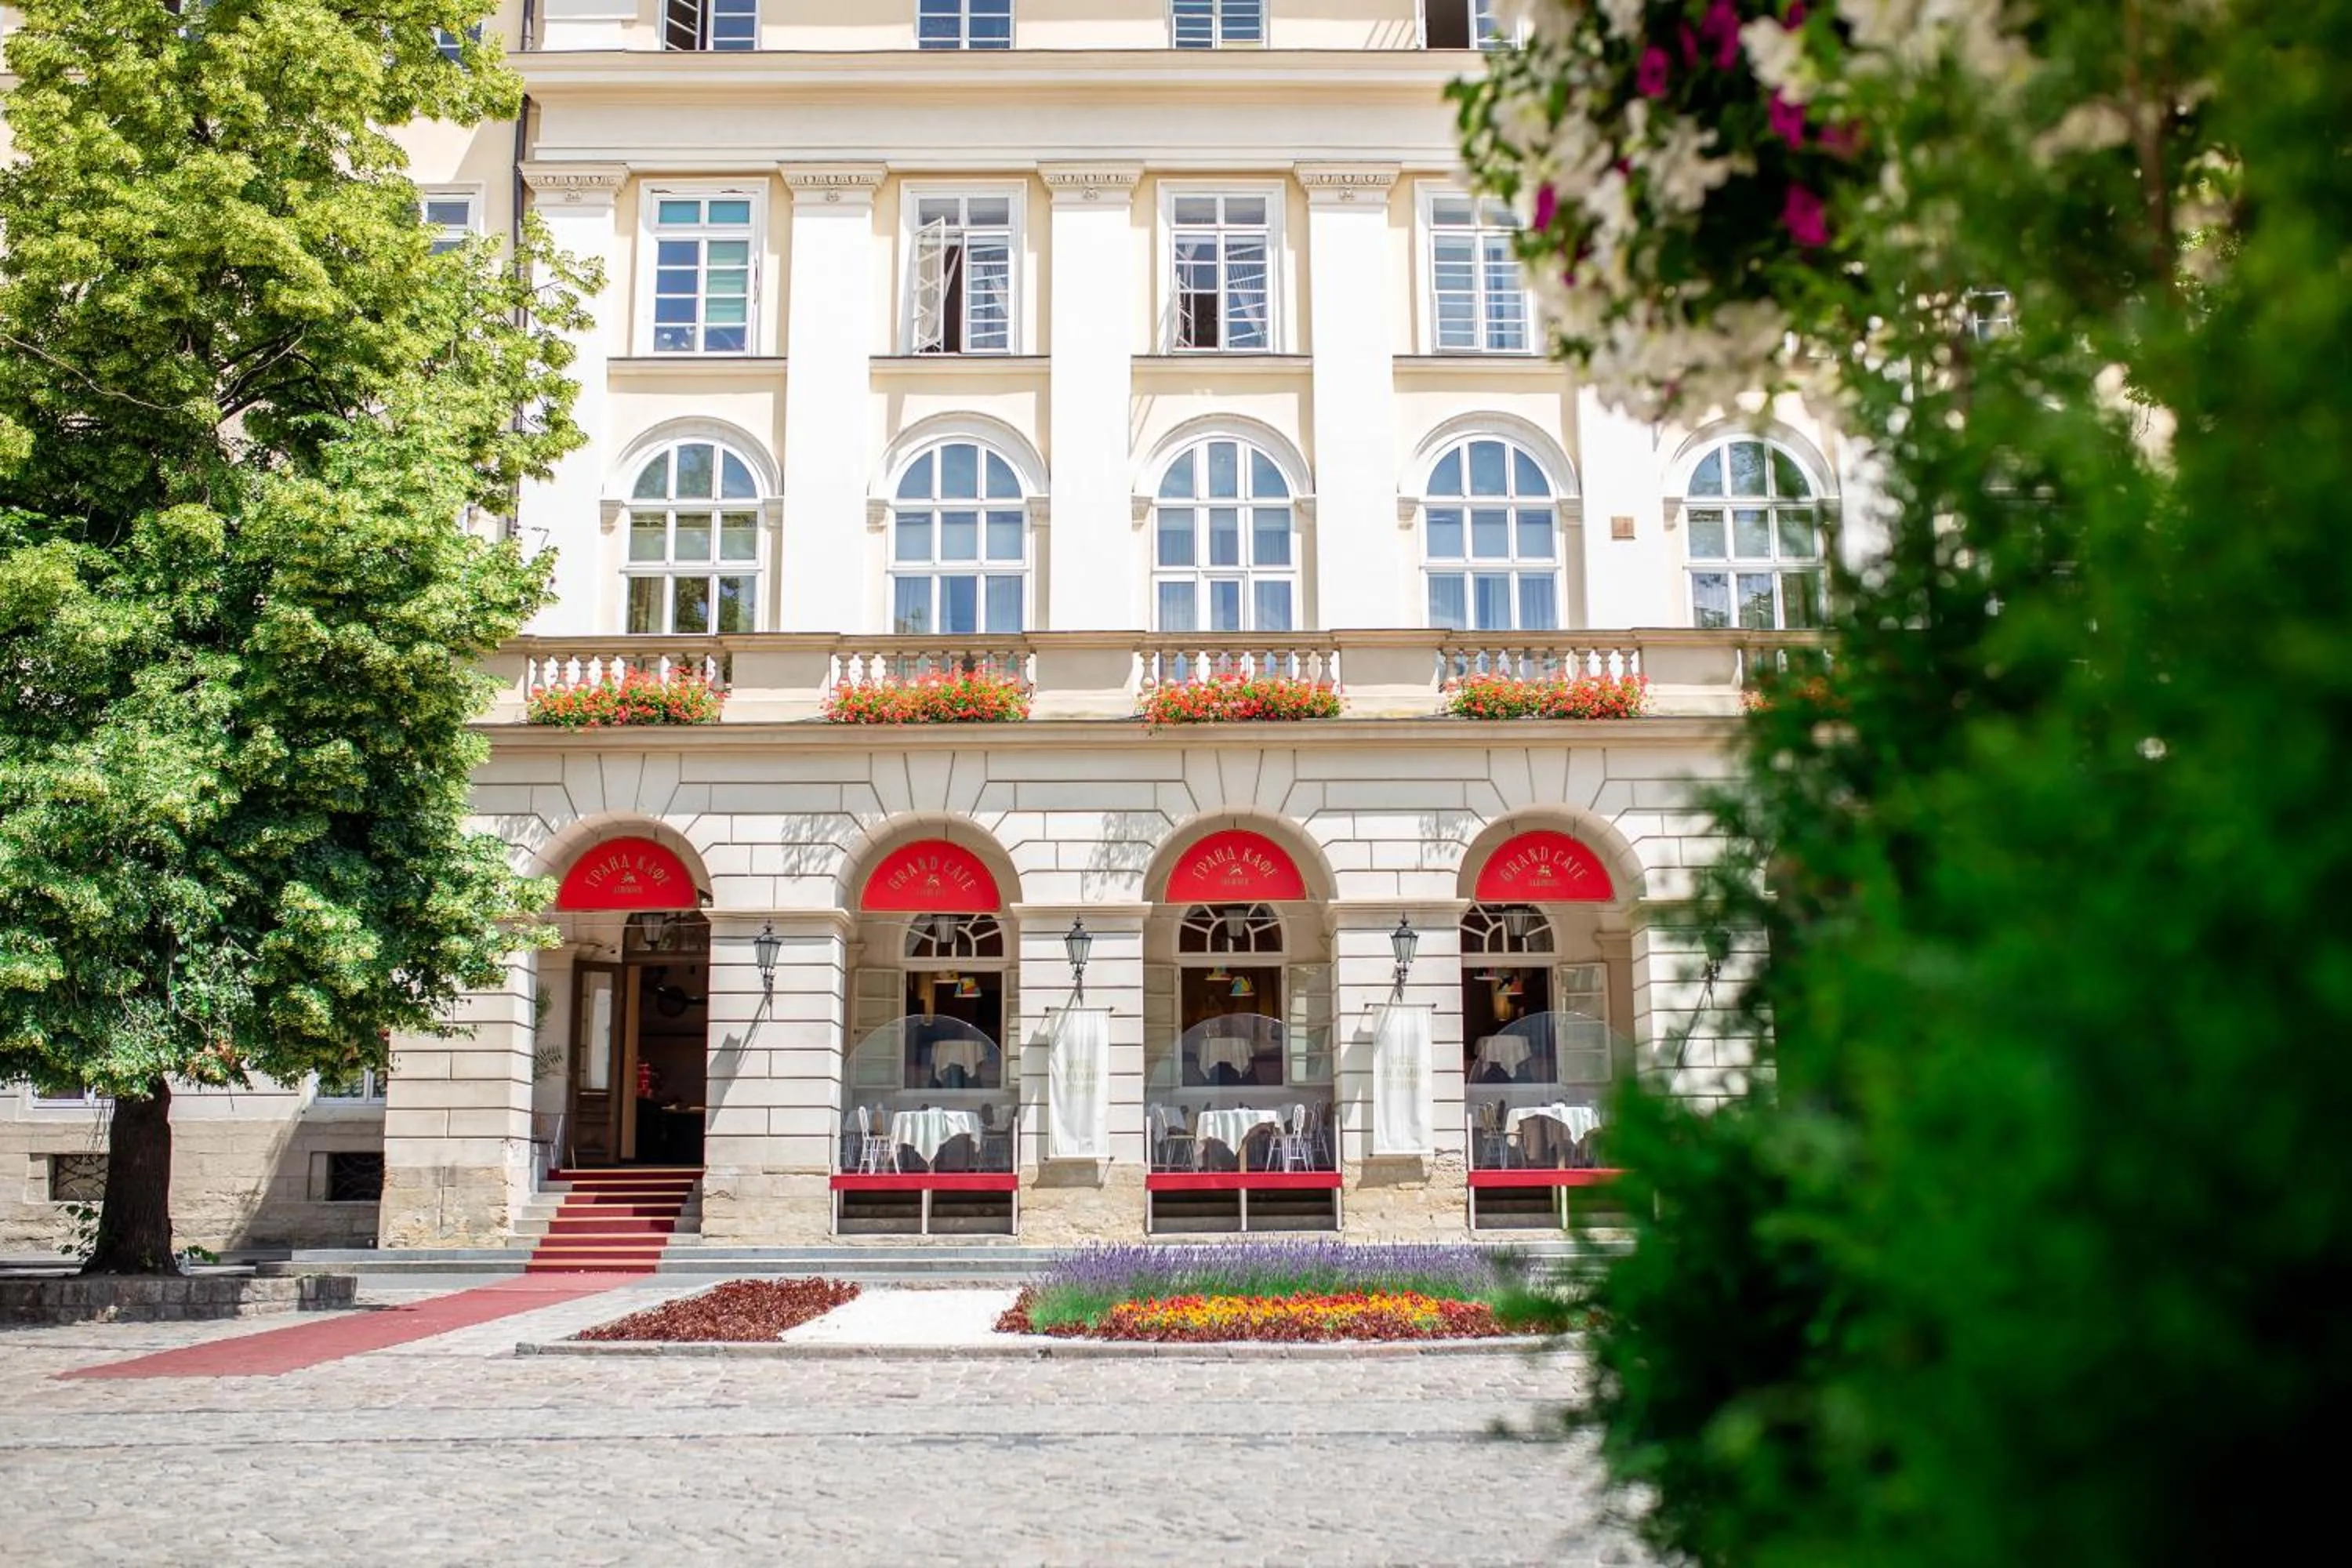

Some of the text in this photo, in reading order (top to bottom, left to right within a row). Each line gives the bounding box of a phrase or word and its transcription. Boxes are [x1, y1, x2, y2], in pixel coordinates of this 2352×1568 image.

[888, 857, 977, 891] GRAND CAFE
[1192, 846, 1236, 879] ГРАНД
[1500, 847, 1548, 881] GRAND
